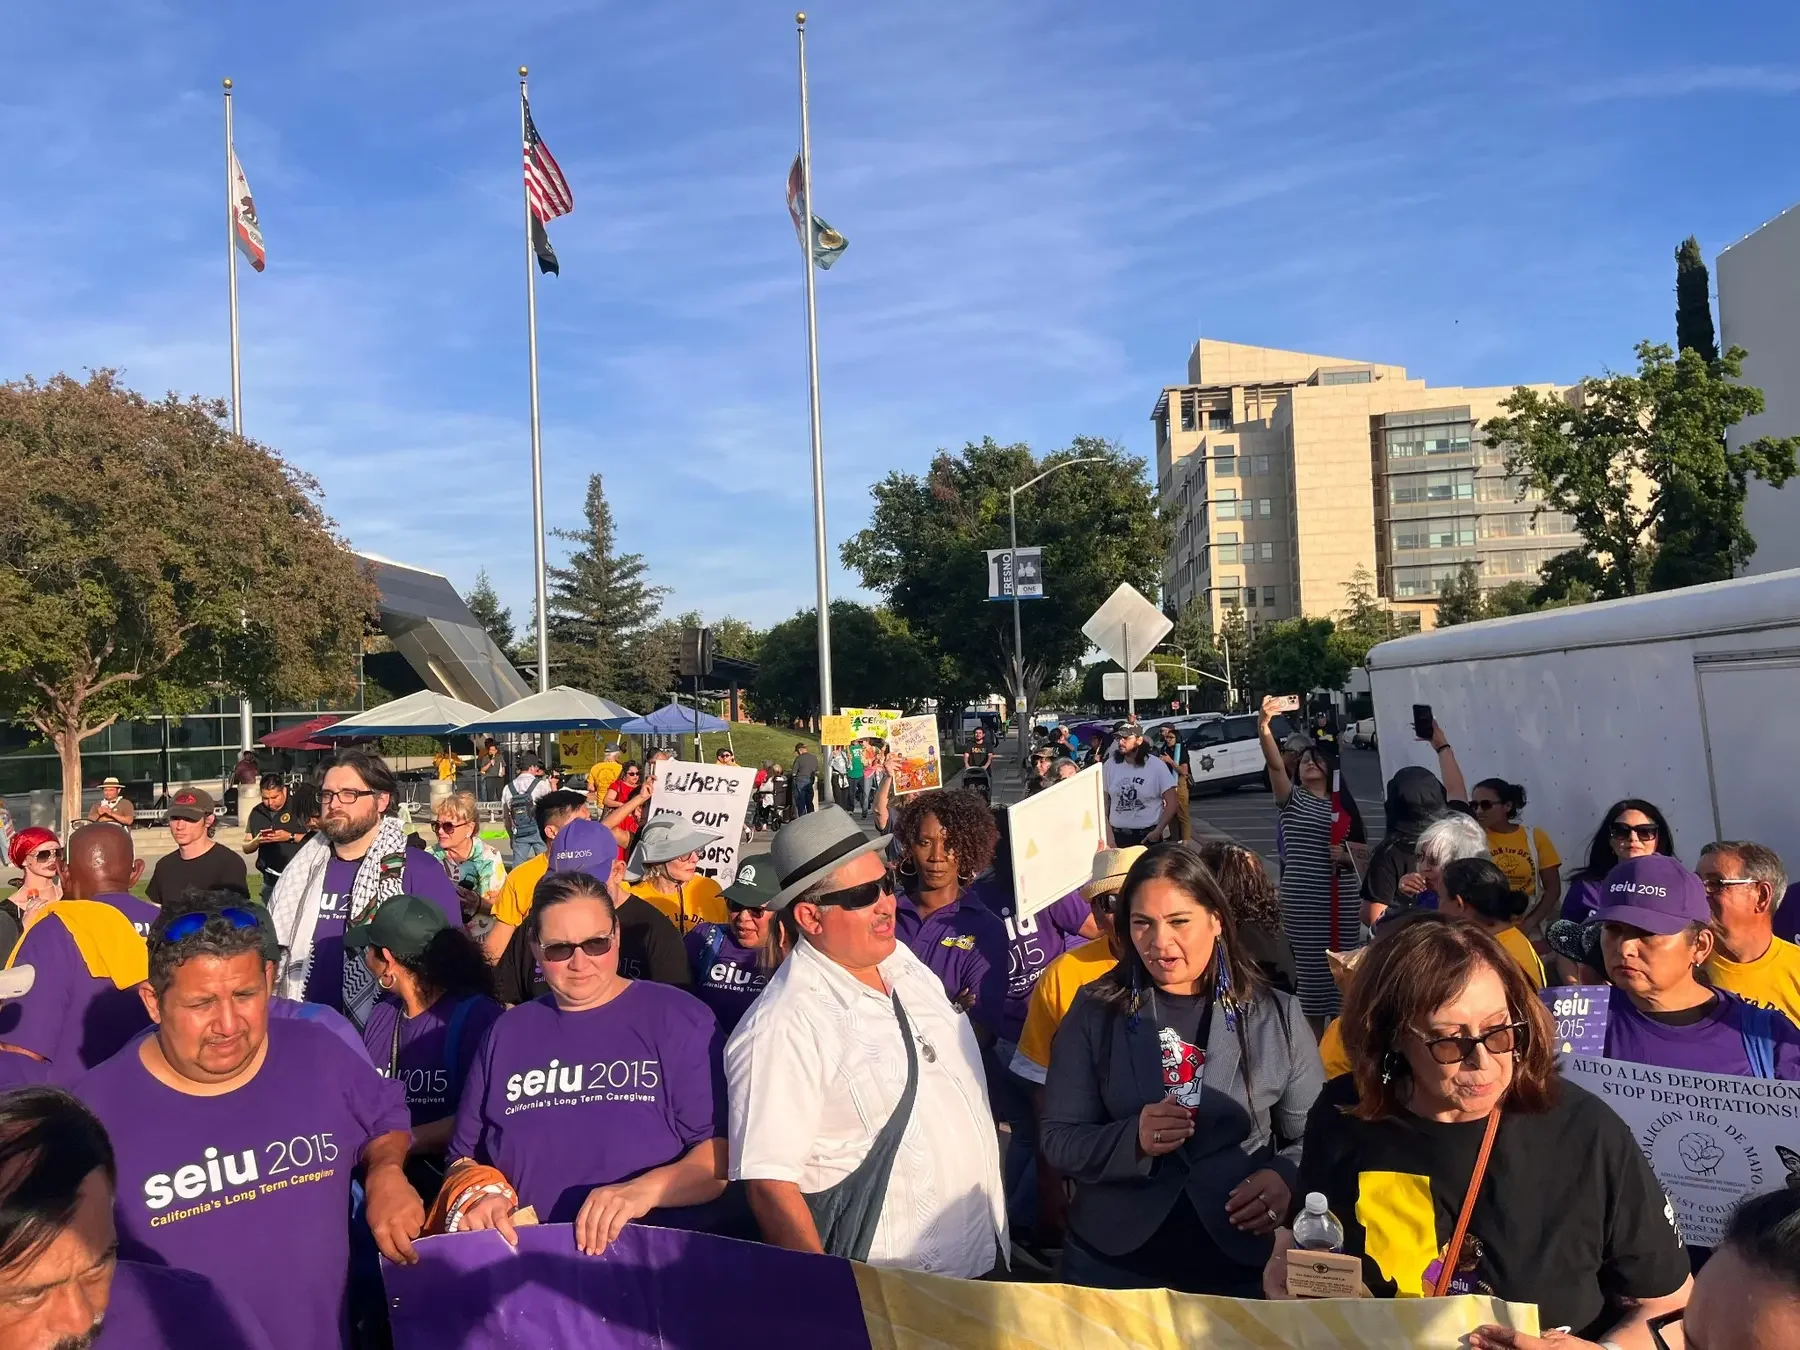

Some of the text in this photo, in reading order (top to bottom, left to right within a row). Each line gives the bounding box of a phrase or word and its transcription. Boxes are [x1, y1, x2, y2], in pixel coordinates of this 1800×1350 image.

[1002, 554, 1012, 595] FRESNO
[664, 772, 740, 794] Where
[1132, 776, 1145, 786] ICE
[691, 810, 730, 828] our
[557, 849, 593, 859] seiu 2015
[1609, 881, 1667, 898] seiu 2015
[710, 961, 752, 984] eiu
[729, 984, 745, 993] Long
[1553, 992, 1589, 1017] seiu
[1554, 1018, 1585, 1039] 2015
[506, 1058, 659, 1102] seiu 2015
[1572, 1058, 1612, 1077] ALTO
[1616, 1066, 1628, 1080] A
[1632, 1068, 1662, 1086] LAS
[406, 1096, 445, 1104] Caregivers
[505, 1092, 656, 1116] California's Long Term Caregivers
[1602, 1081, 1799, 1119] STOP DEPORTATIONS!
[1688, 1110, 1720, 1128] 1RO.
[1724, 1124, 1747, 1145] DE
[1743, 1146, 1764, 1185] MAYO
[144, 1133, 339, 1210] seiu 2015
[150, 1199, 222, 1228] California's
[225, 1188, 257, 1206] Long
[259, 1179, 288, 1195] Term
